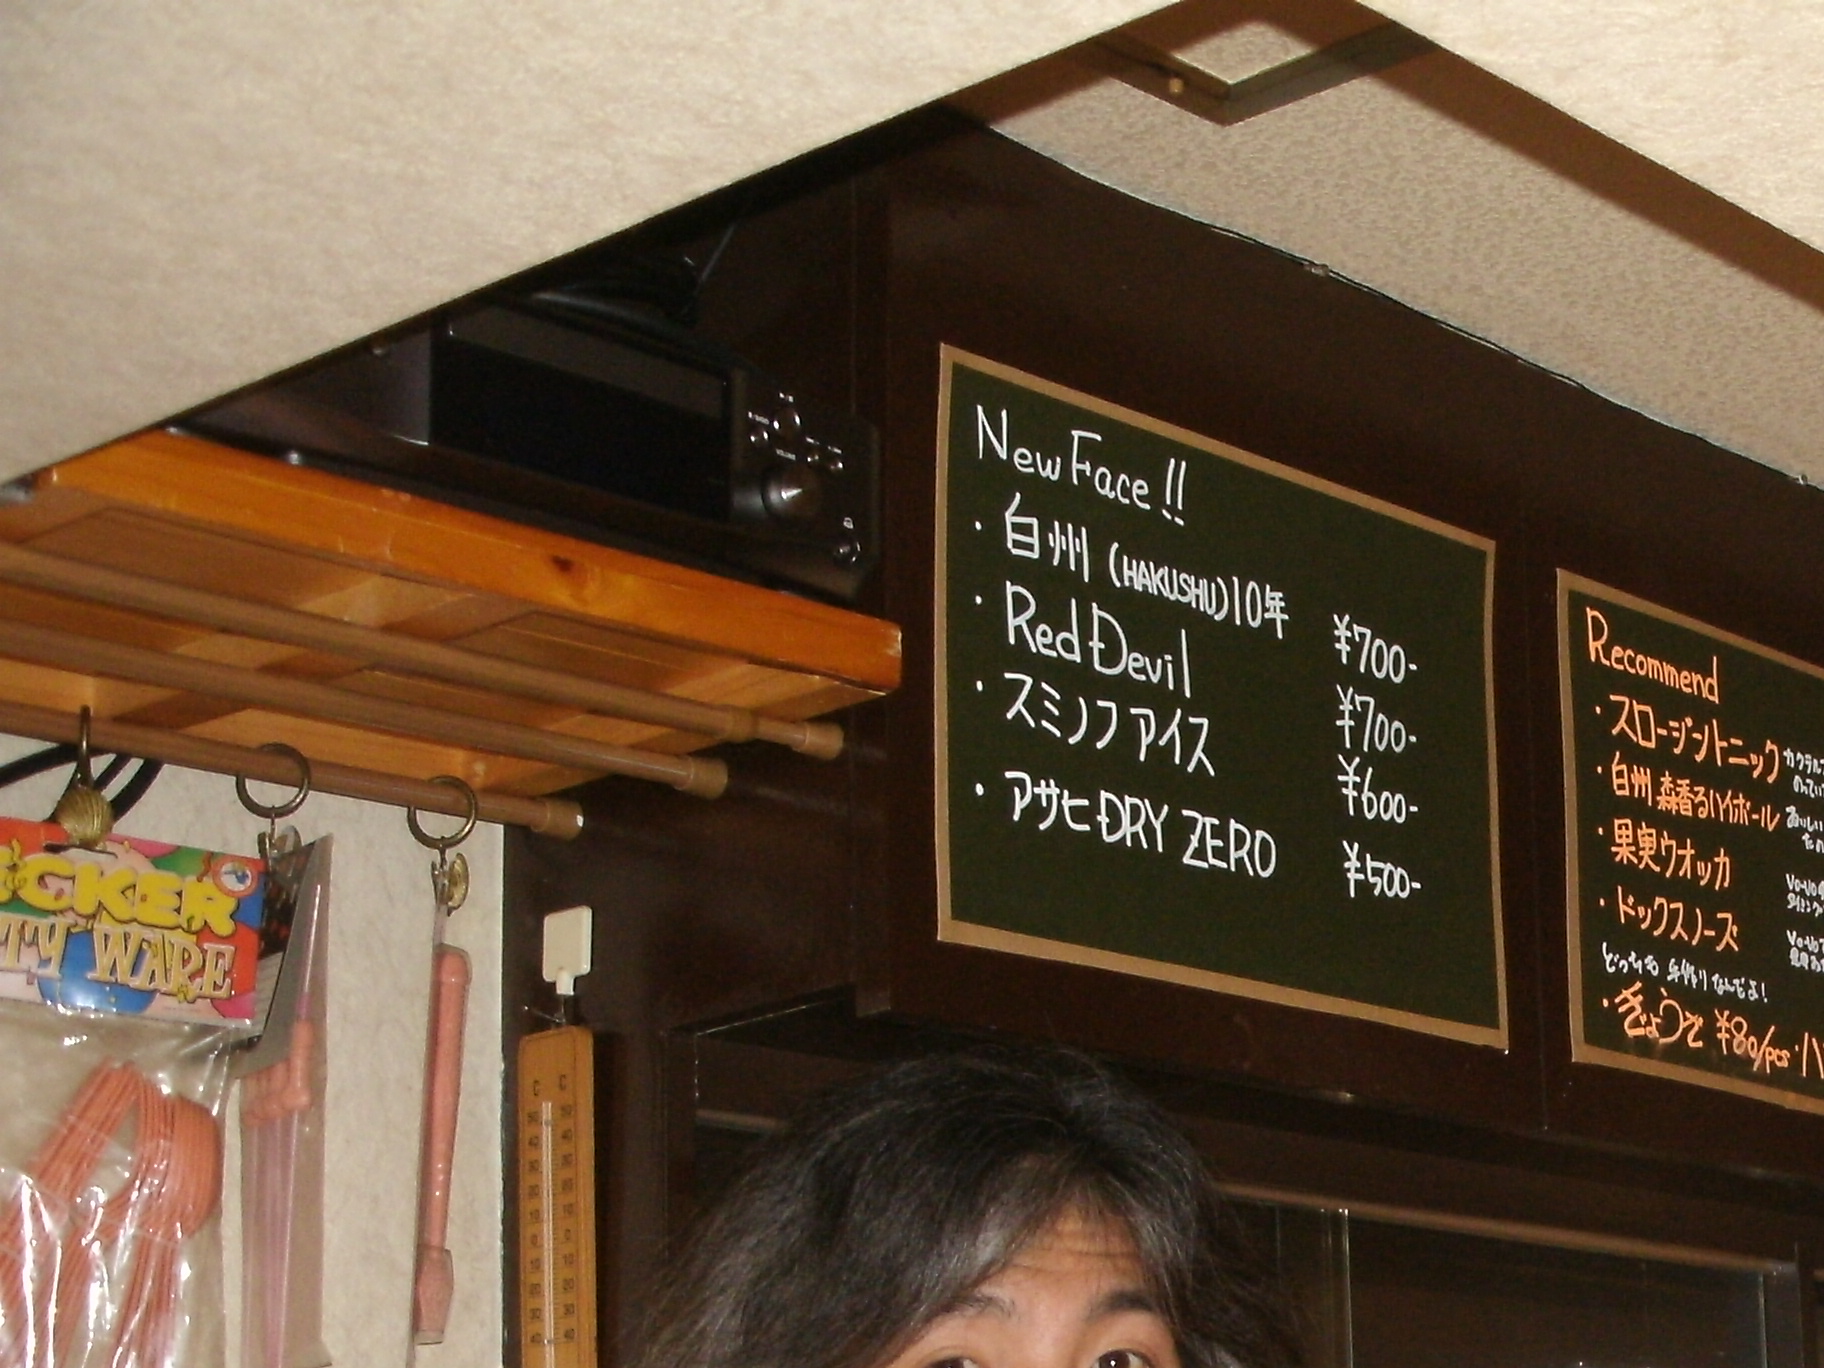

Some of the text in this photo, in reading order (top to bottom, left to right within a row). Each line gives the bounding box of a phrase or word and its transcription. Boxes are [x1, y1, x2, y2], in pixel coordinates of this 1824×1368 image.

[976, 404, 1062, 479] New
[1071, 430, 1150, 508] Face
[1005, 492, 1090, 582] 白州
[1005, 581, 1079, 664] Red
[1091, 602, 1191, 698] Devil
[1586, 607, 1719, 703] Recommend
[1611, 752, 1652, 806] 白州
[1182, 810, 1277, 877] ZERO
[86, 921, 235, 999] WARE
